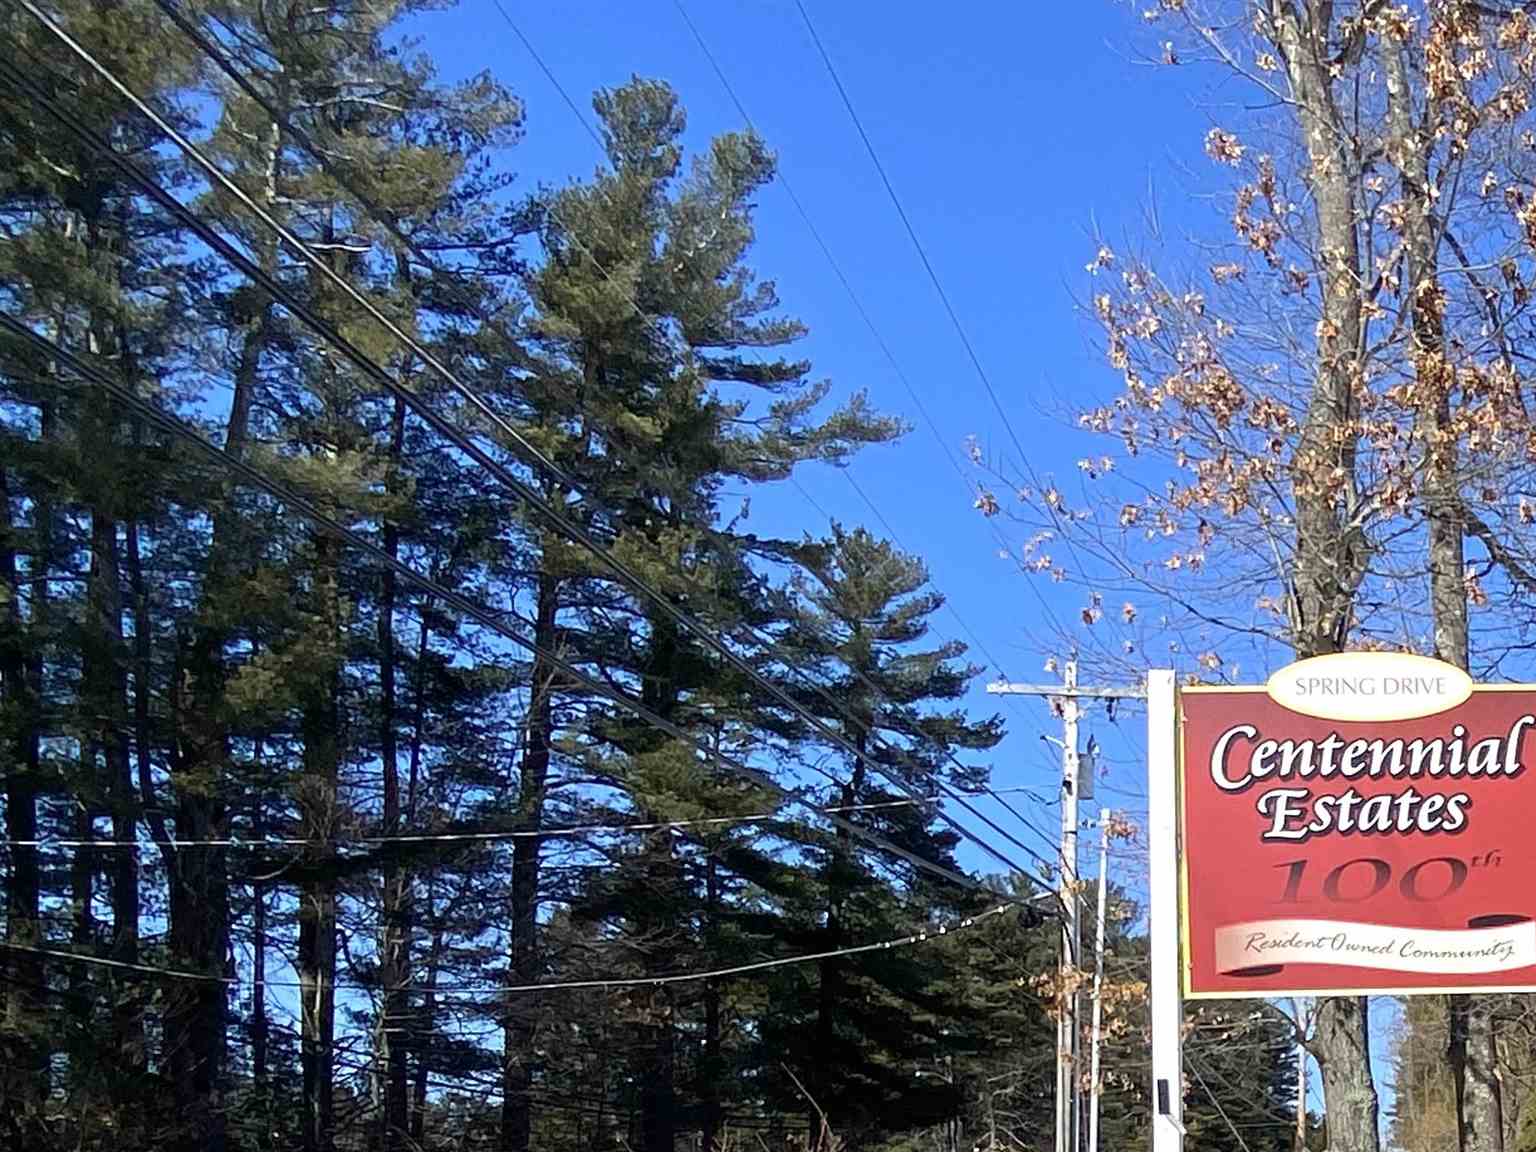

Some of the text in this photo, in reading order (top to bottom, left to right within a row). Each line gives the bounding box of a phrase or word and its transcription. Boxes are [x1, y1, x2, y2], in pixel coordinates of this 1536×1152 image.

[1295, 677, 1447, 696] SPRING DRIVE
[1210, 714, 1536, 790] Centennial
[1257, 788, 1469, 840] Estates
[1244, 932, 1515, 962] Resident Owned Community
